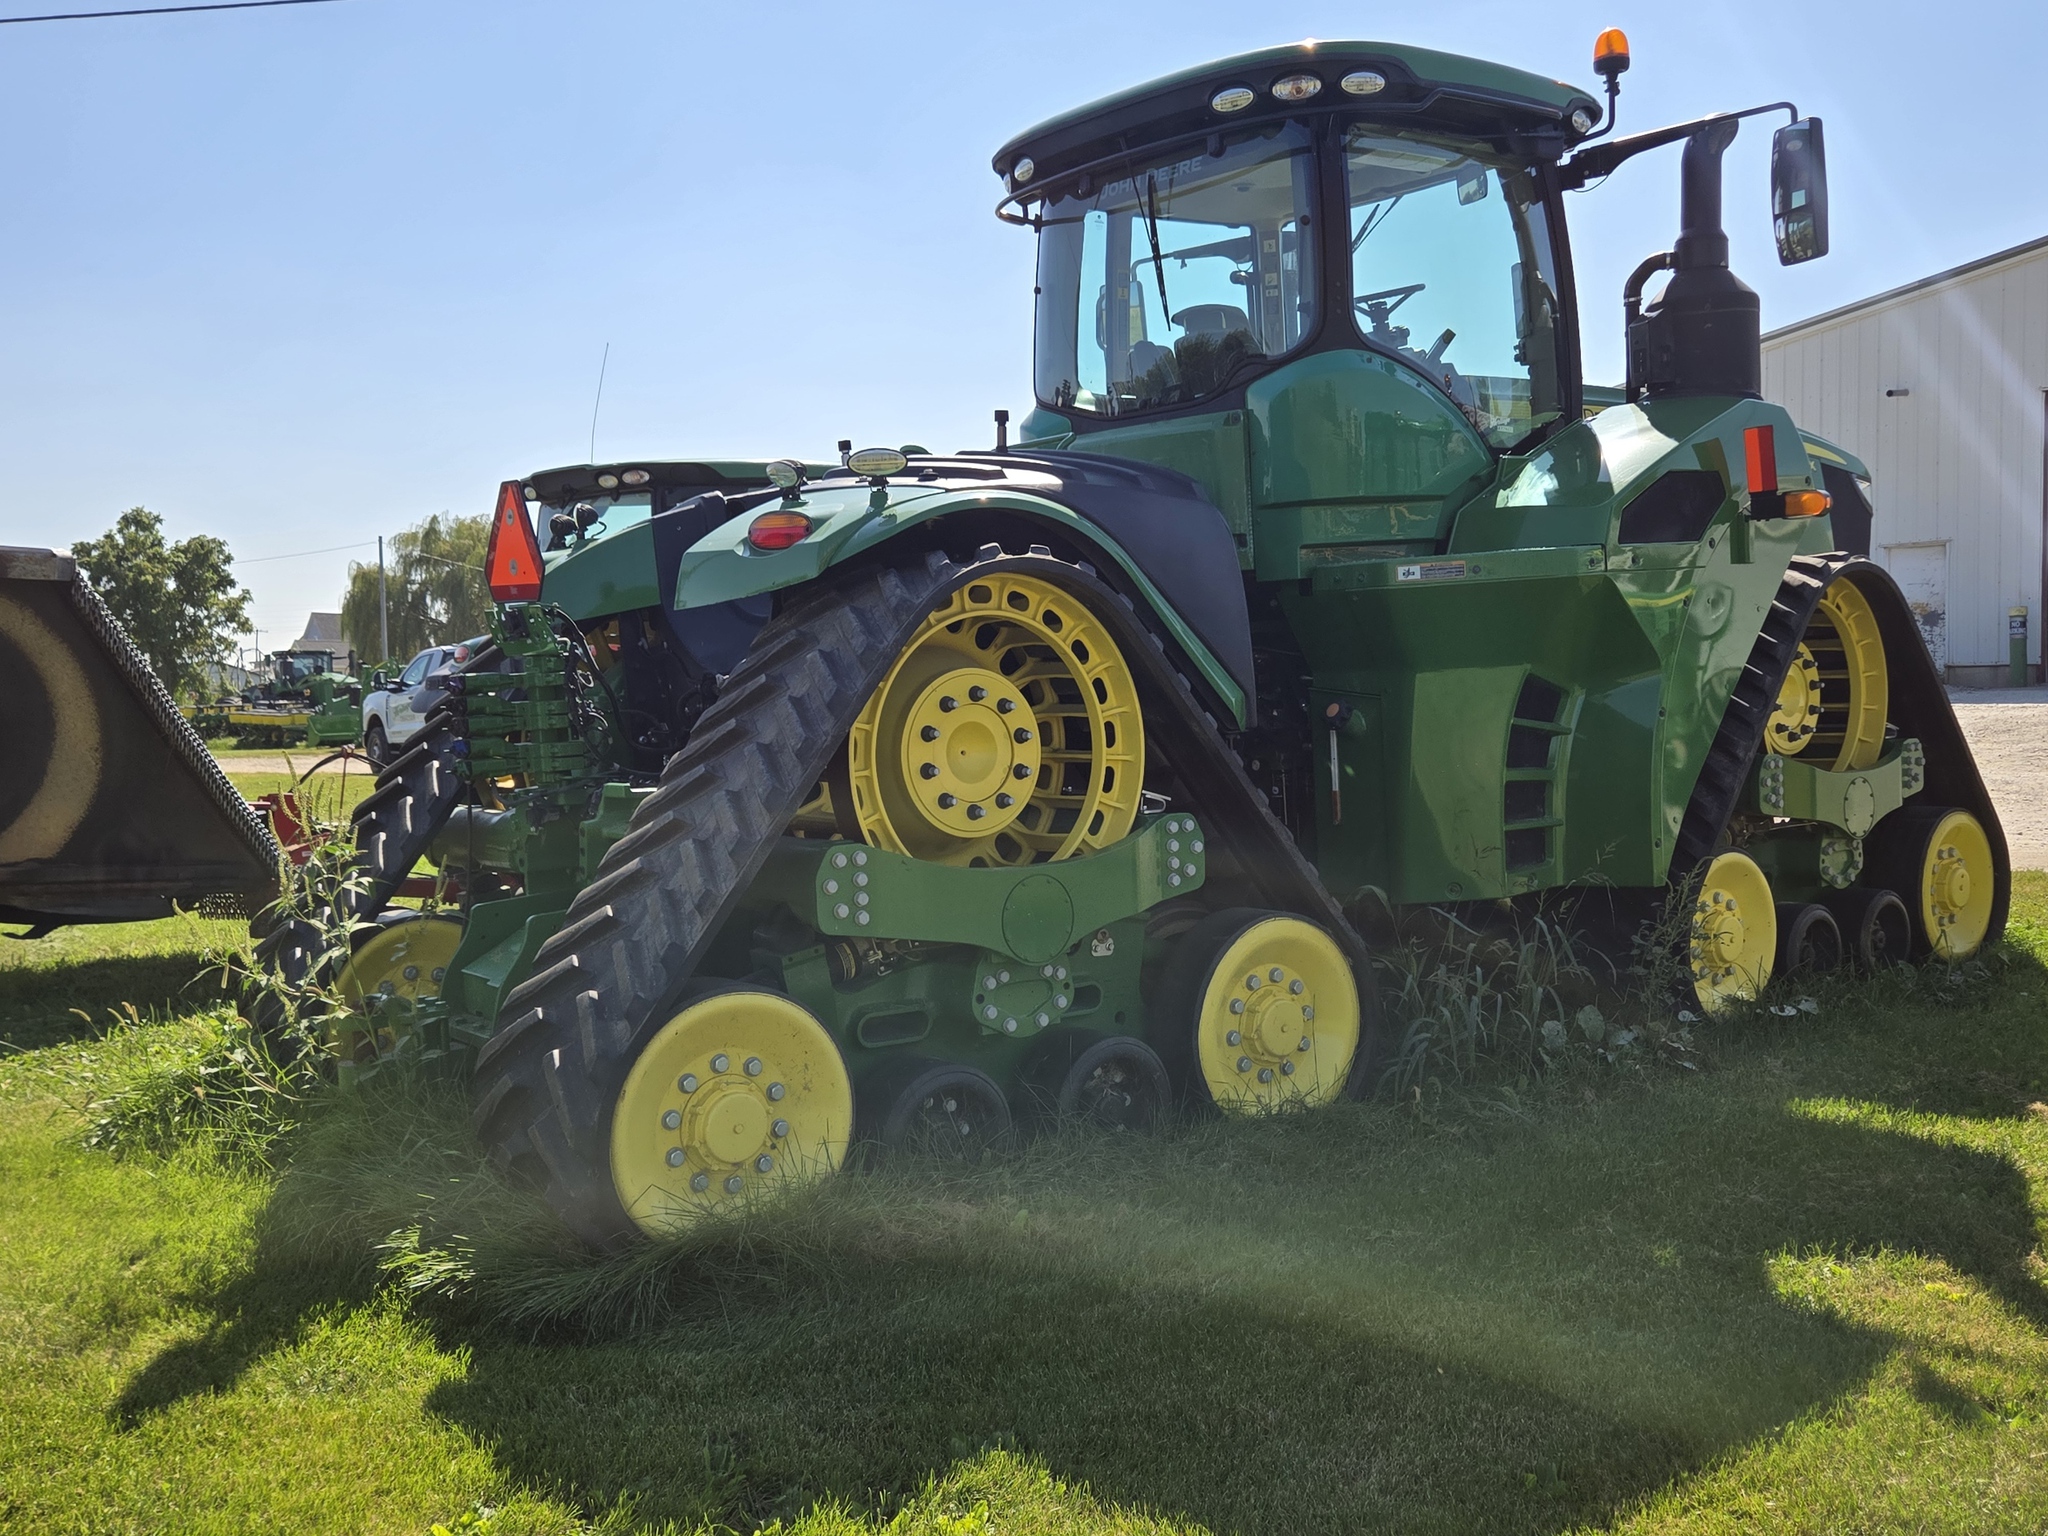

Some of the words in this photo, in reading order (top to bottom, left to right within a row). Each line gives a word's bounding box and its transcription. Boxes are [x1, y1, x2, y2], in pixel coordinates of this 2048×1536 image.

[1100, 175, 1141, 200] JOHN
[1146, 156, 1203, 186] DEERE
[2010, 620, 2021, 628] NO
